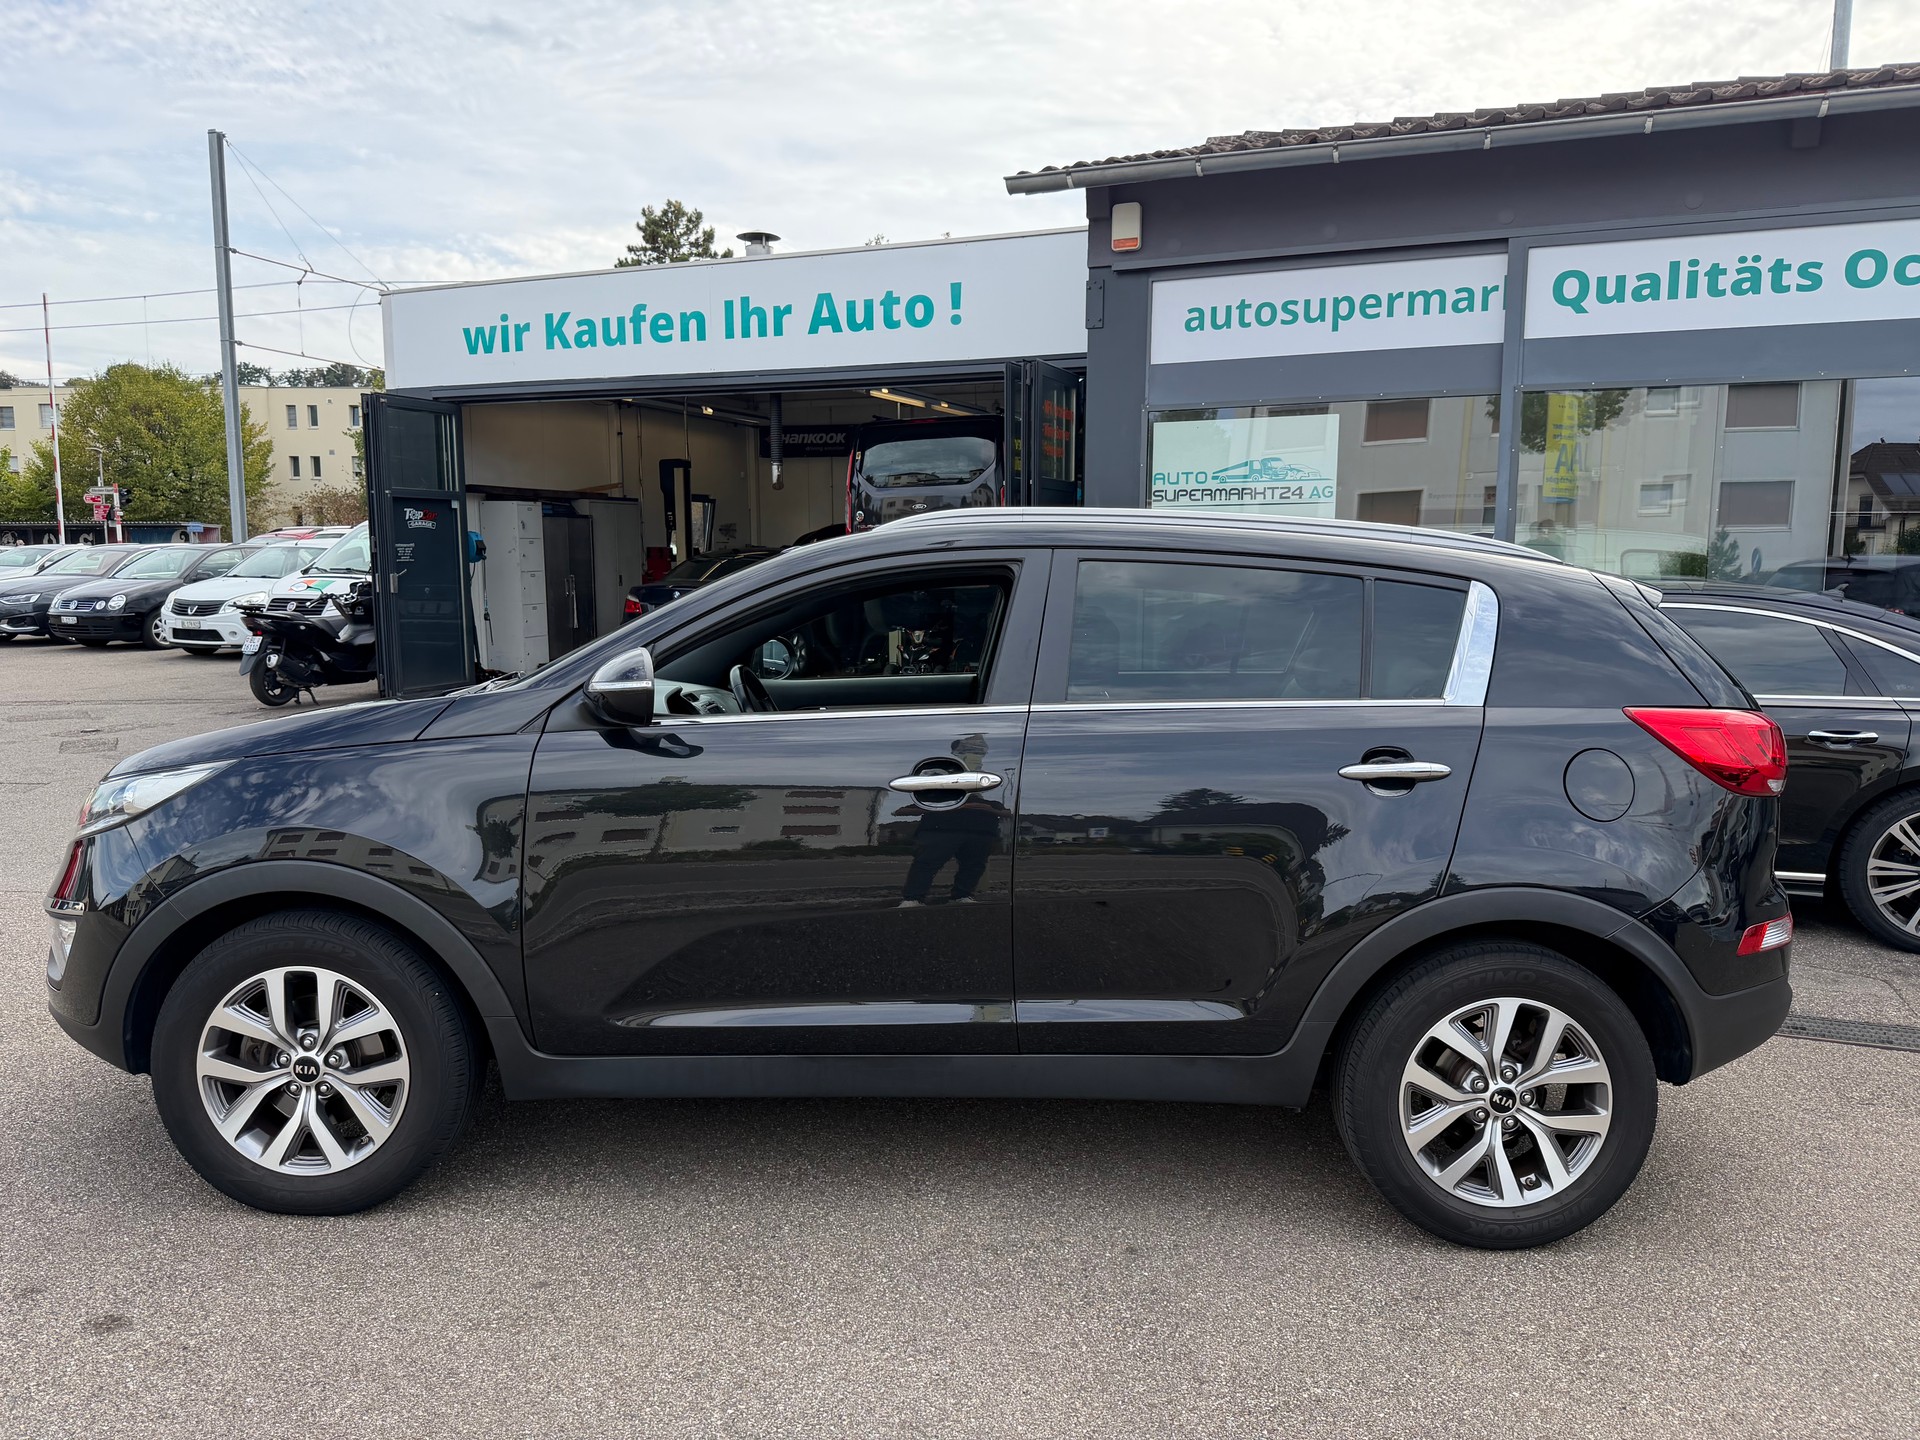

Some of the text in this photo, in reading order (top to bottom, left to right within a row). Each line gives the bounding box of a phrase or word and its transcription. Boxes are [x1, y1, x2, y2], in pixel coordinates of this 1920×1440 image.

[1551, 254, 1824, 315] Qualitäts
[1184, 274, 1507, 334] autosupermar
[462, 312, 532, 357] wir
[544, 302, 708, 351] Kaufen
[723, 295, 794, 342] Ihr
[806, 289, 936, 336] Auto
[1152, 471, 1208, 486] AUTO
[1152, 485, 1334, 502] SUPERMARKT24 AG
[295, 1064, 317, 1075] KIA
[1492, 1093, 1513, 1109] KIA
